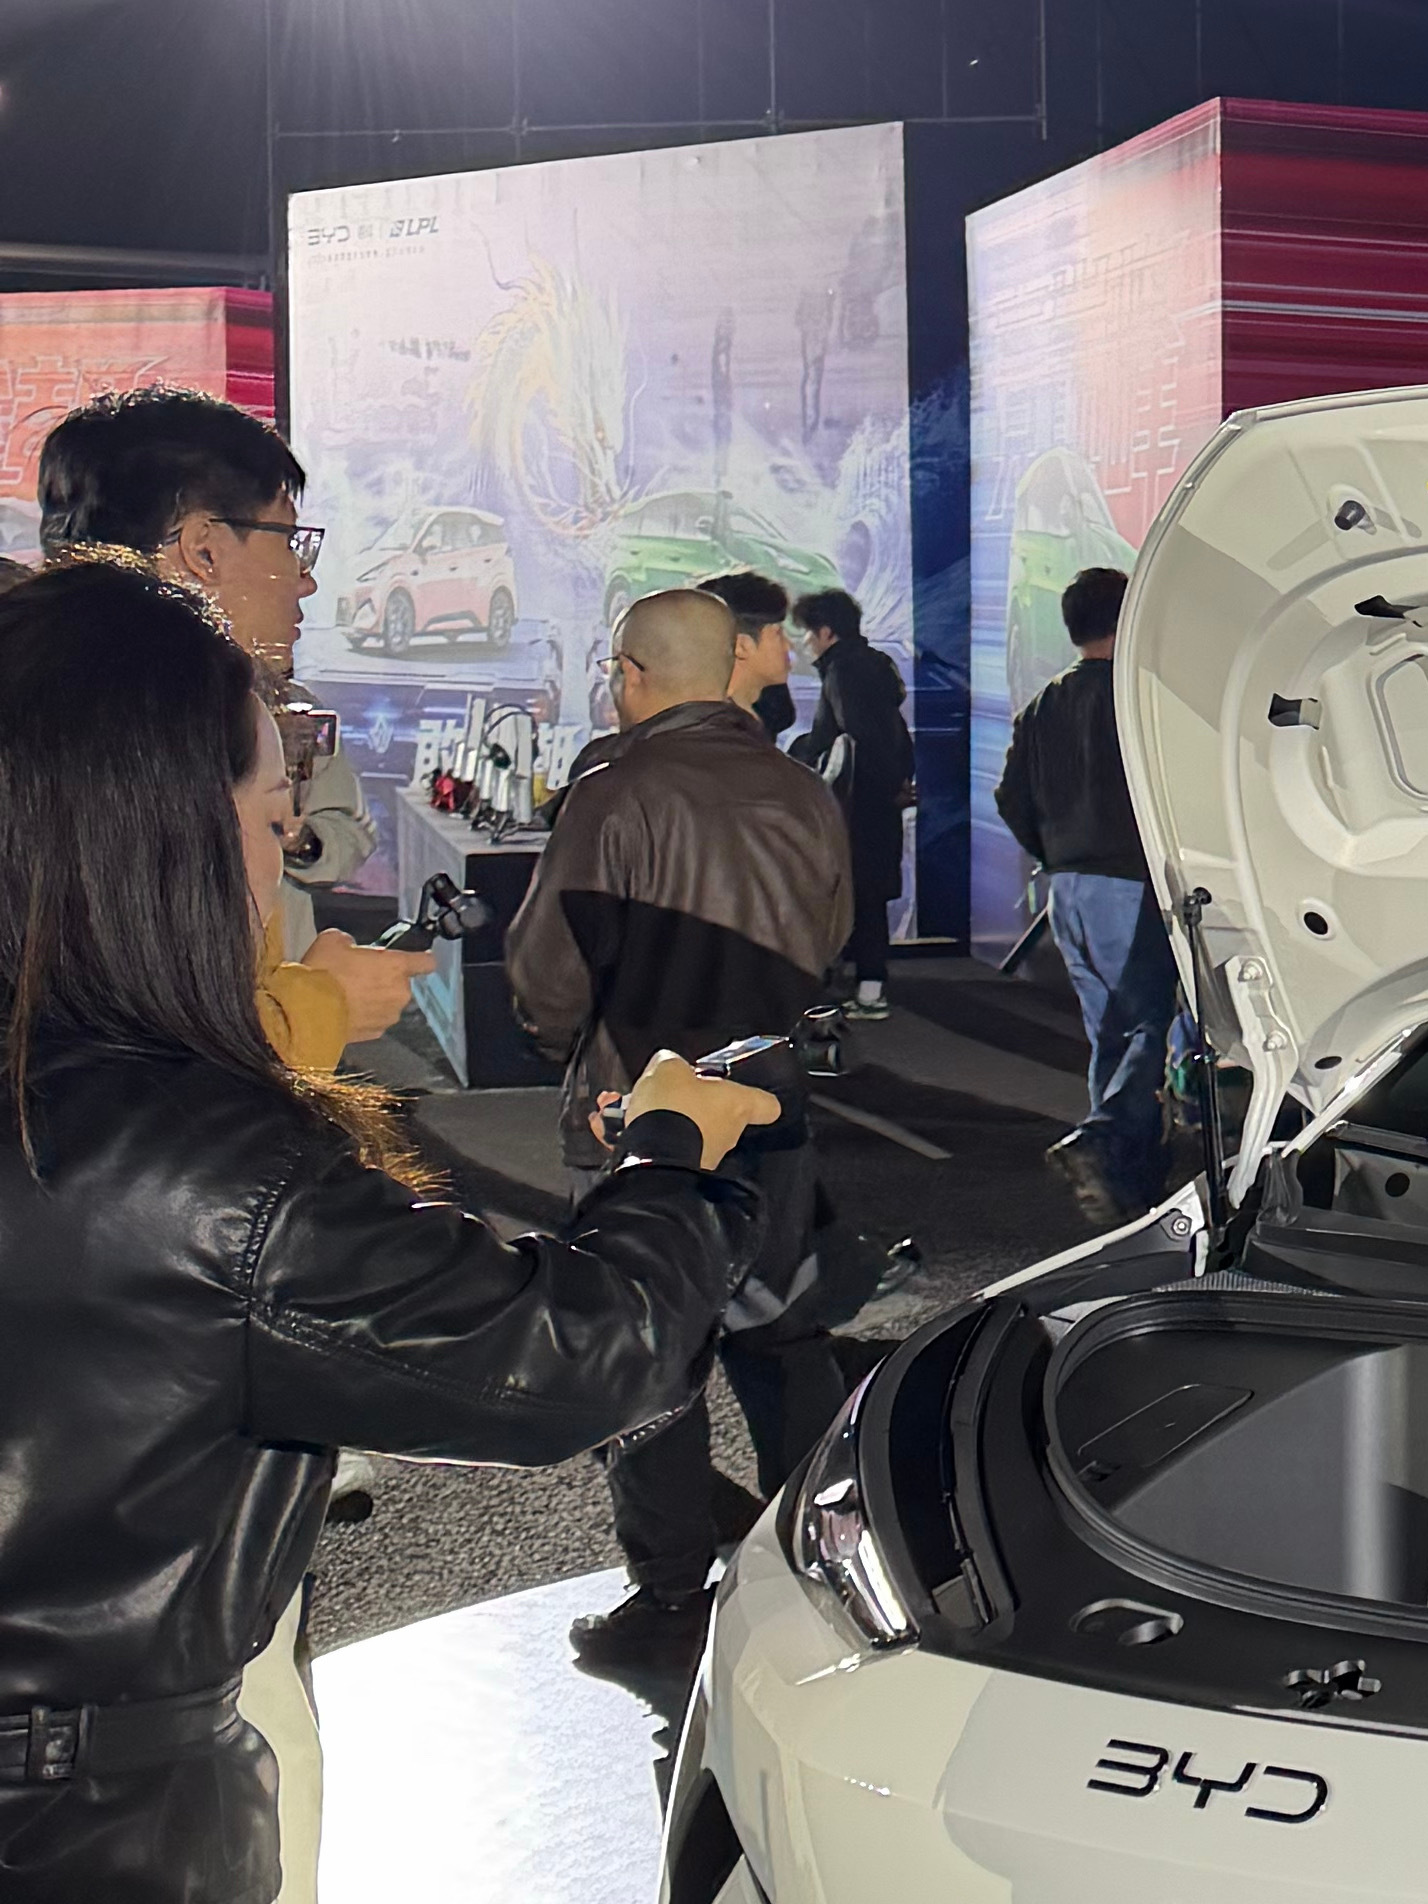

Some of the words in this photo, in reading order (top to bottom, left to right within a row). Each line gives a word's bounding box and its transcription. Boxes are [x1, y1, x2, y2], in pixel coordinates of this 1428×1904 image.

[307, 224, 351, 246] BYD
[405, 216, 440, 237] LPL
[1086, 1738, 1329, 1824] BYD
